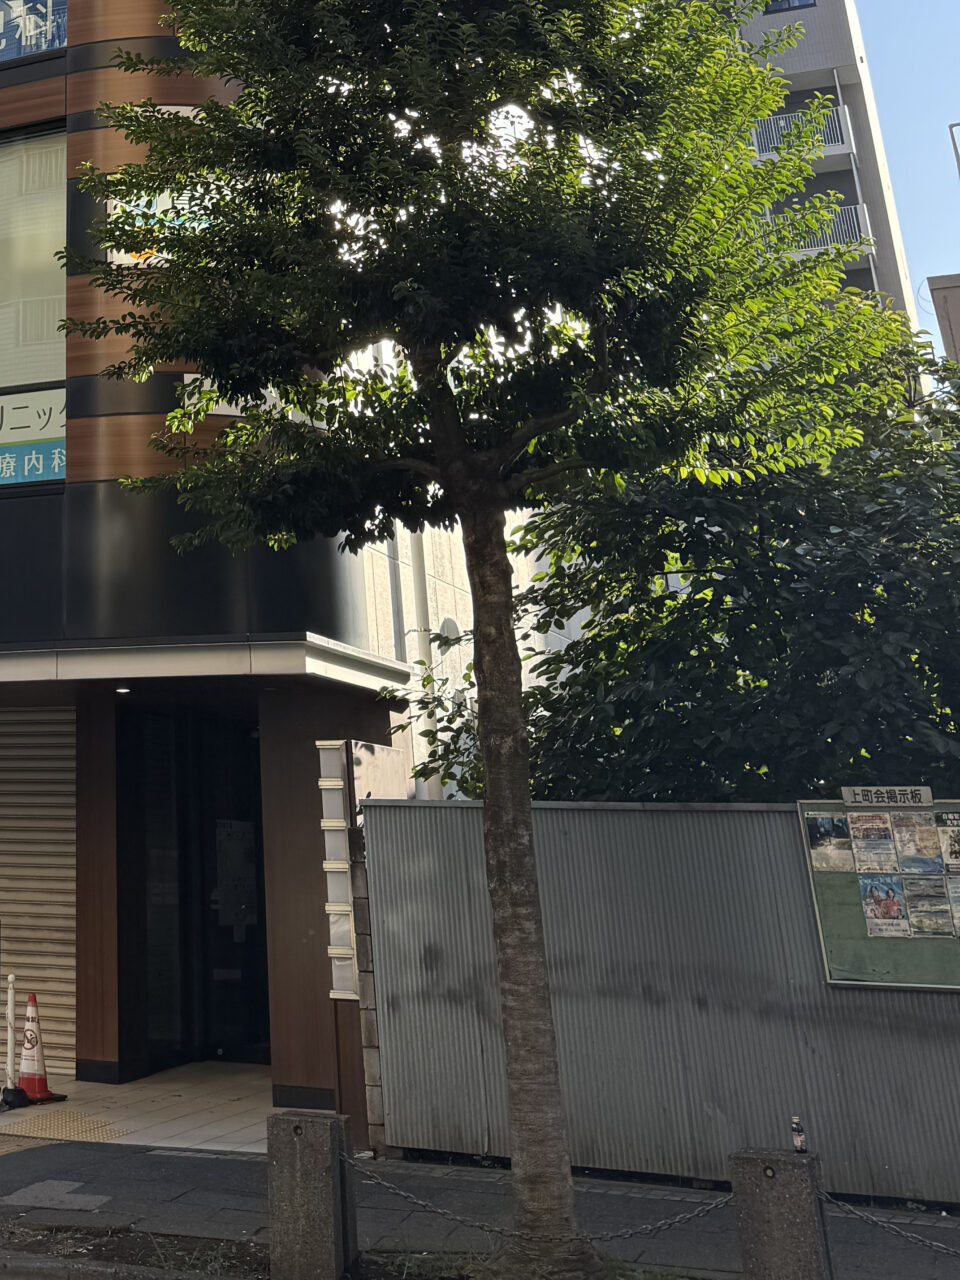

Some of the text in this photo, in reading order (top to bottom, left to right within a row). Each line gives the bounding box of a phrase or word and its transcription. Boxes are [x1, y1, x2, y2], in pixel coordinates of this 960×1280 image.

[850, 788, 923, 804] 上町会掲示板
